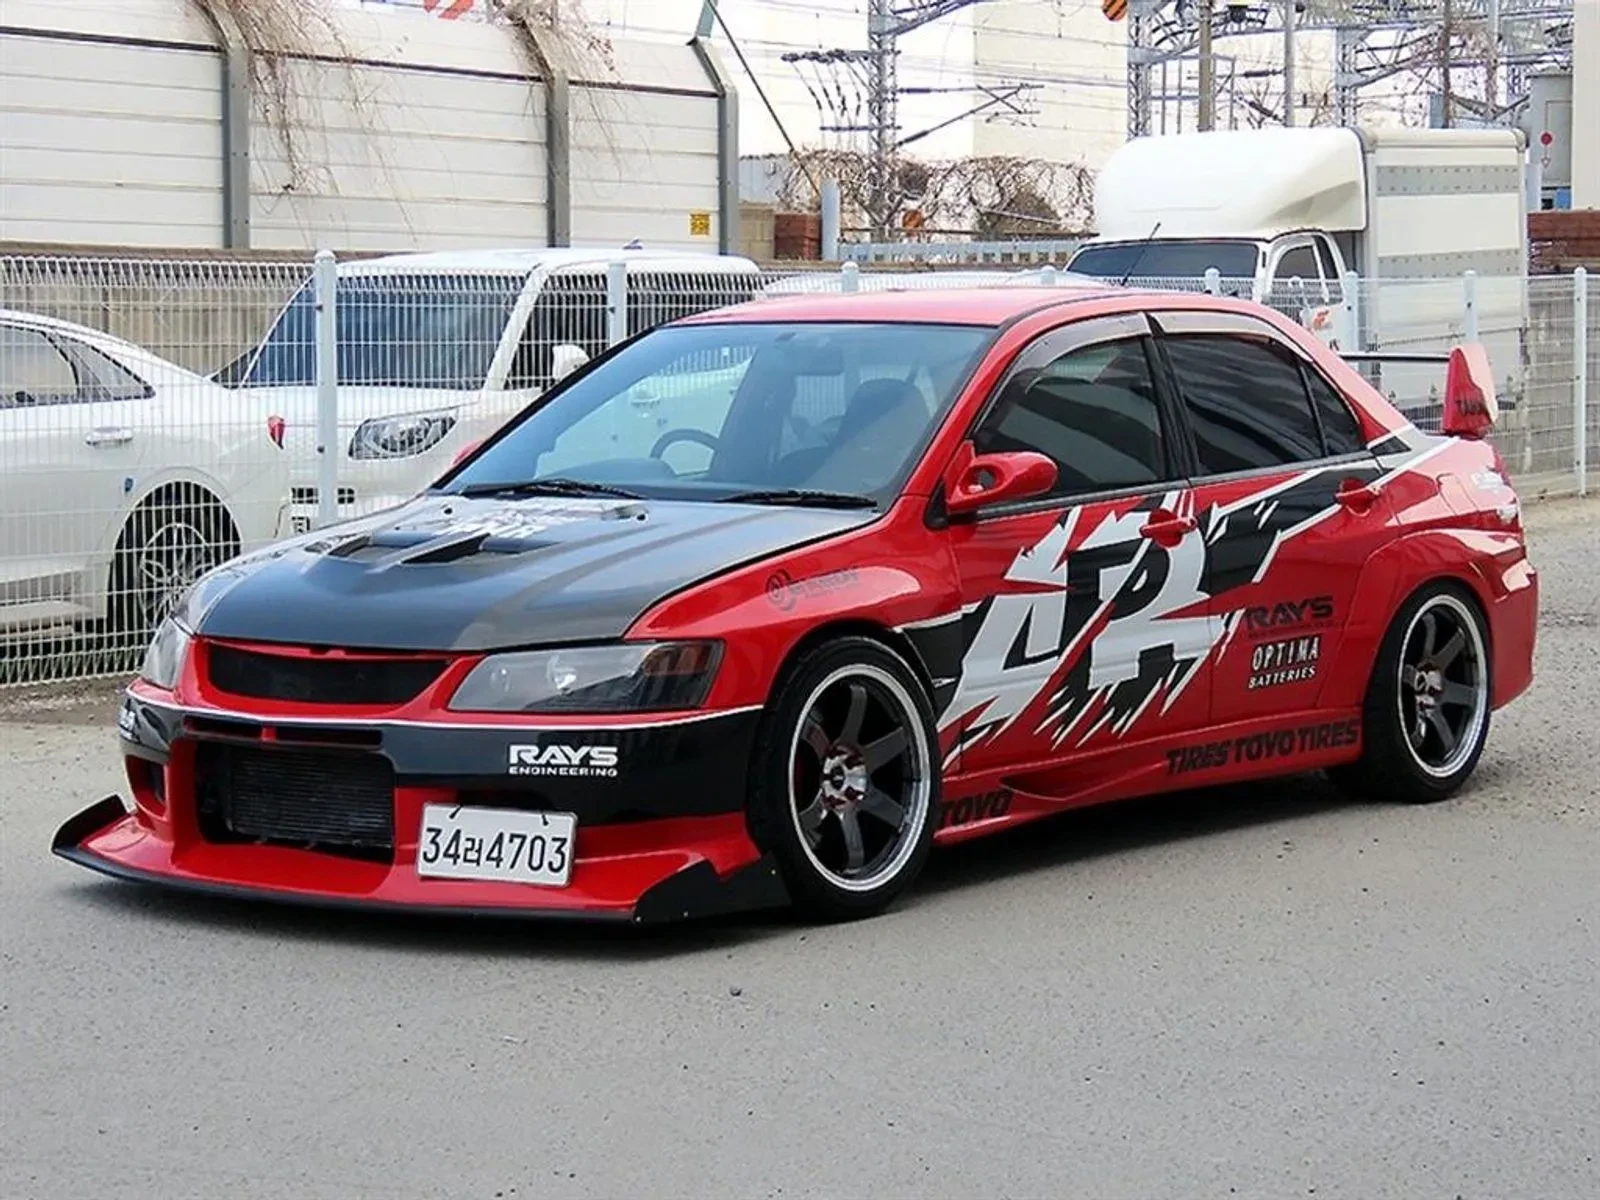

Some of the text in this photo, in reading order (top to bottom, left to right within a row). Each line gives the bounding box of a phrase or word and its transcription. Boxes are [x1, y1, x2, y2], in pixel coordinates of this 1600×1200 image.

[1246, 596, 1333, 628] RAYS
[1252, 636, 1319, 671] OPTIMA
[1248, 665, 1316, 688] BATTERIES
[509, 744, 618, 766] RAYS
[1167, 740, 1230, 775] TIRES
[1296, 717, 1359, 753] TIRES
[509, 766, 618, 777] ENGINEERING
